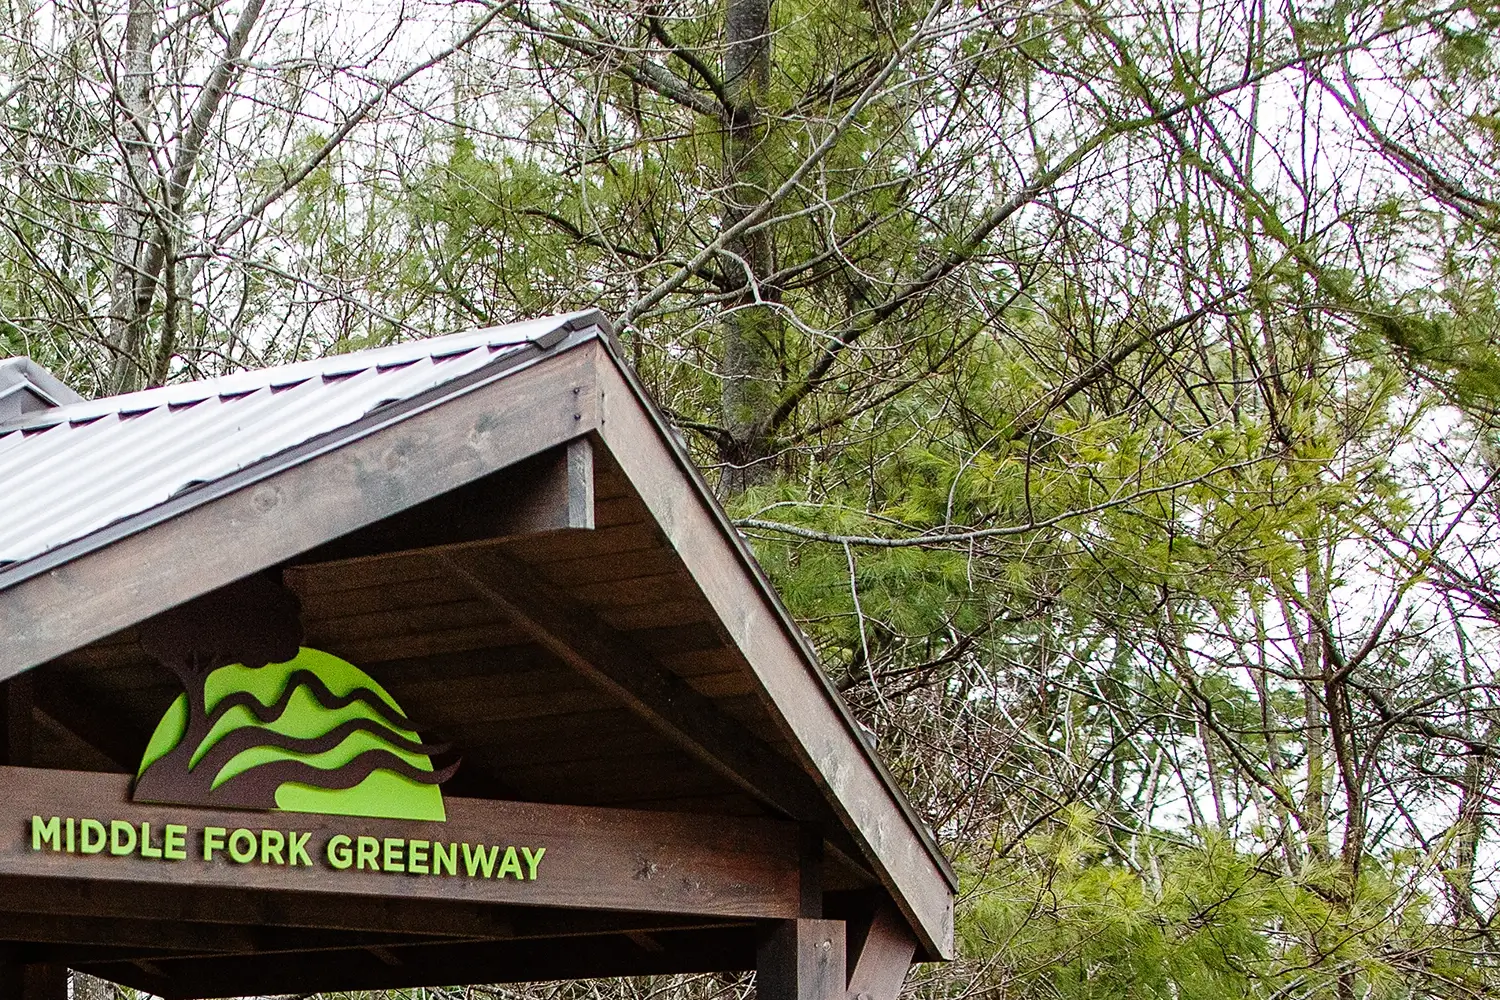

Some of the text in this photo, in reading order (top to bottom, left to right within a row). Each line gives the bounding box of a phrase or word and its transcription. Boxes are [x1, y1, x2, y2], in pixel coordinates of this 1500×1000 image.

[31, 815, 546, 881] MIDDLE FORK GREENWAY
